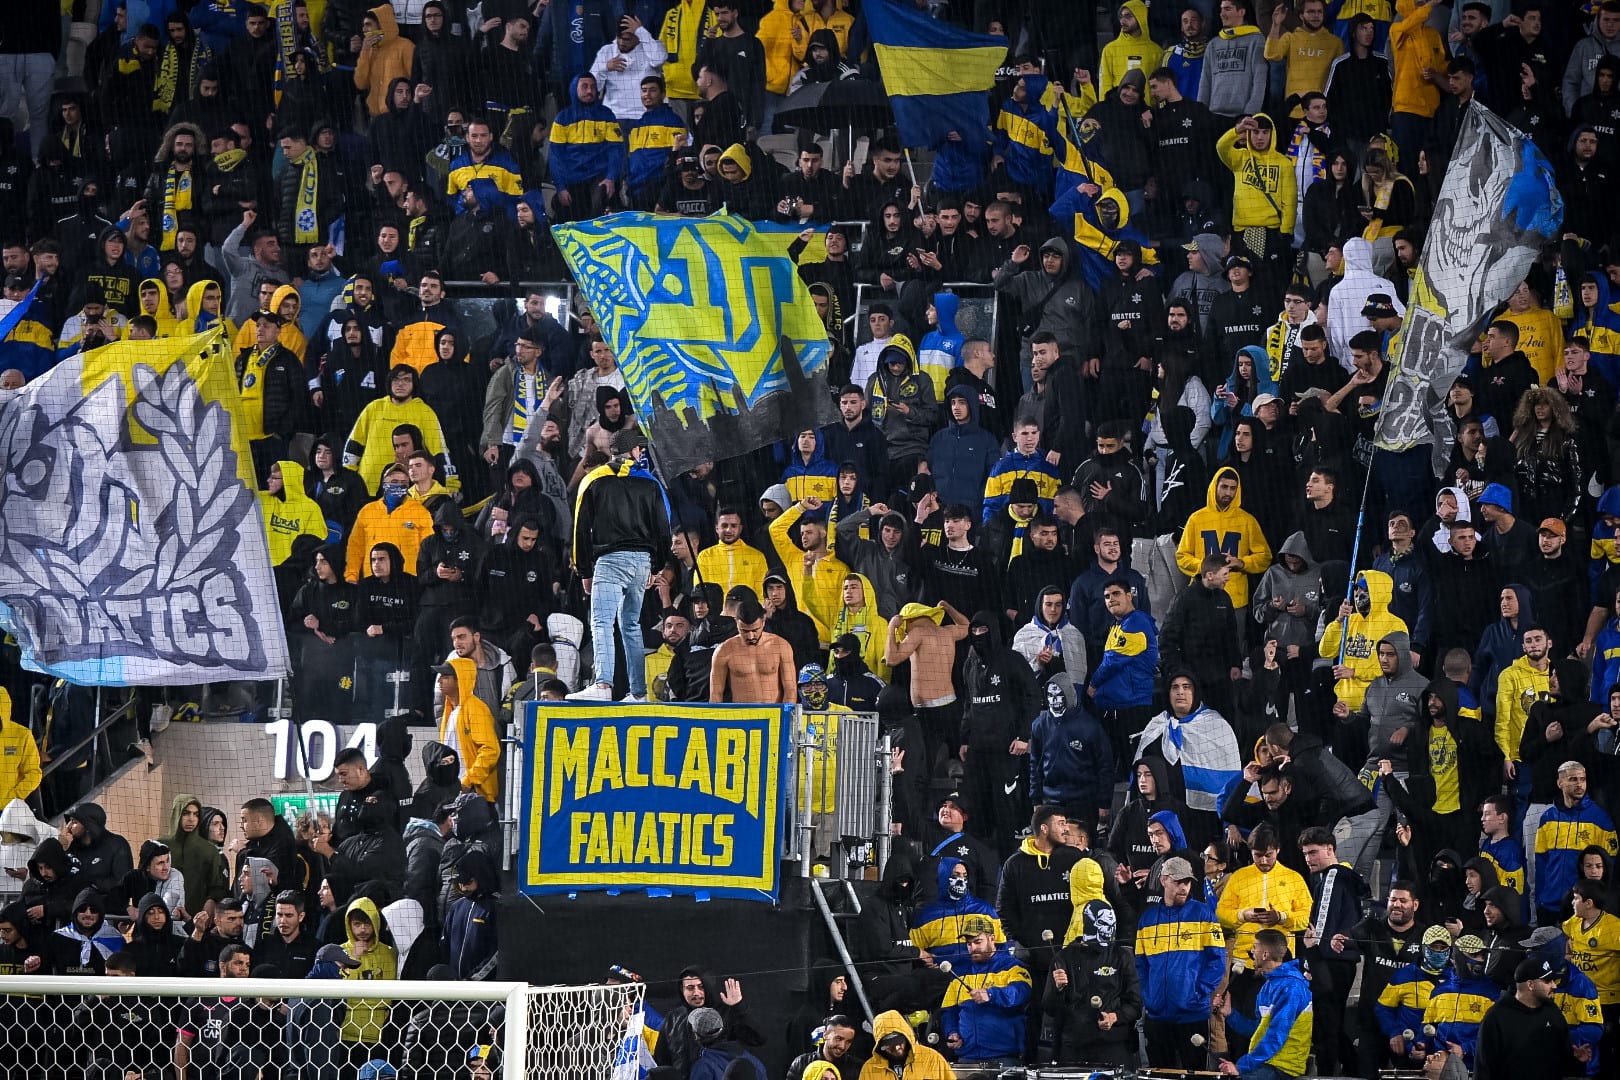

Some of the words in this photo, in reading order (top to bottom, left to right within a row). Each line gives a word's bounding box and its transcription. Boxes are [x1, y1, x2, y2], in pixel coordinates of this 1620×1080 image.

[1593, 124, 1615, 135] ATICS
[1224, 324, 1260, 334] FANATICS
[518, 368, 528, 400] MACC
[14, 570, 252, 663] NATICS
[264, 718, 380, 783] 104
[550, 725, 763, 820] MACCABI
[568, 811, 736, 867] FANATICS
[1131, 844, 1158, 854] FANAT
[1029, 892, 1070, 904] FANATICS
[1574, 962, 1599, 972] ADA
[206, 1019, 223, 1029] ISR
[203, 1028, 221, 1039] CAN
